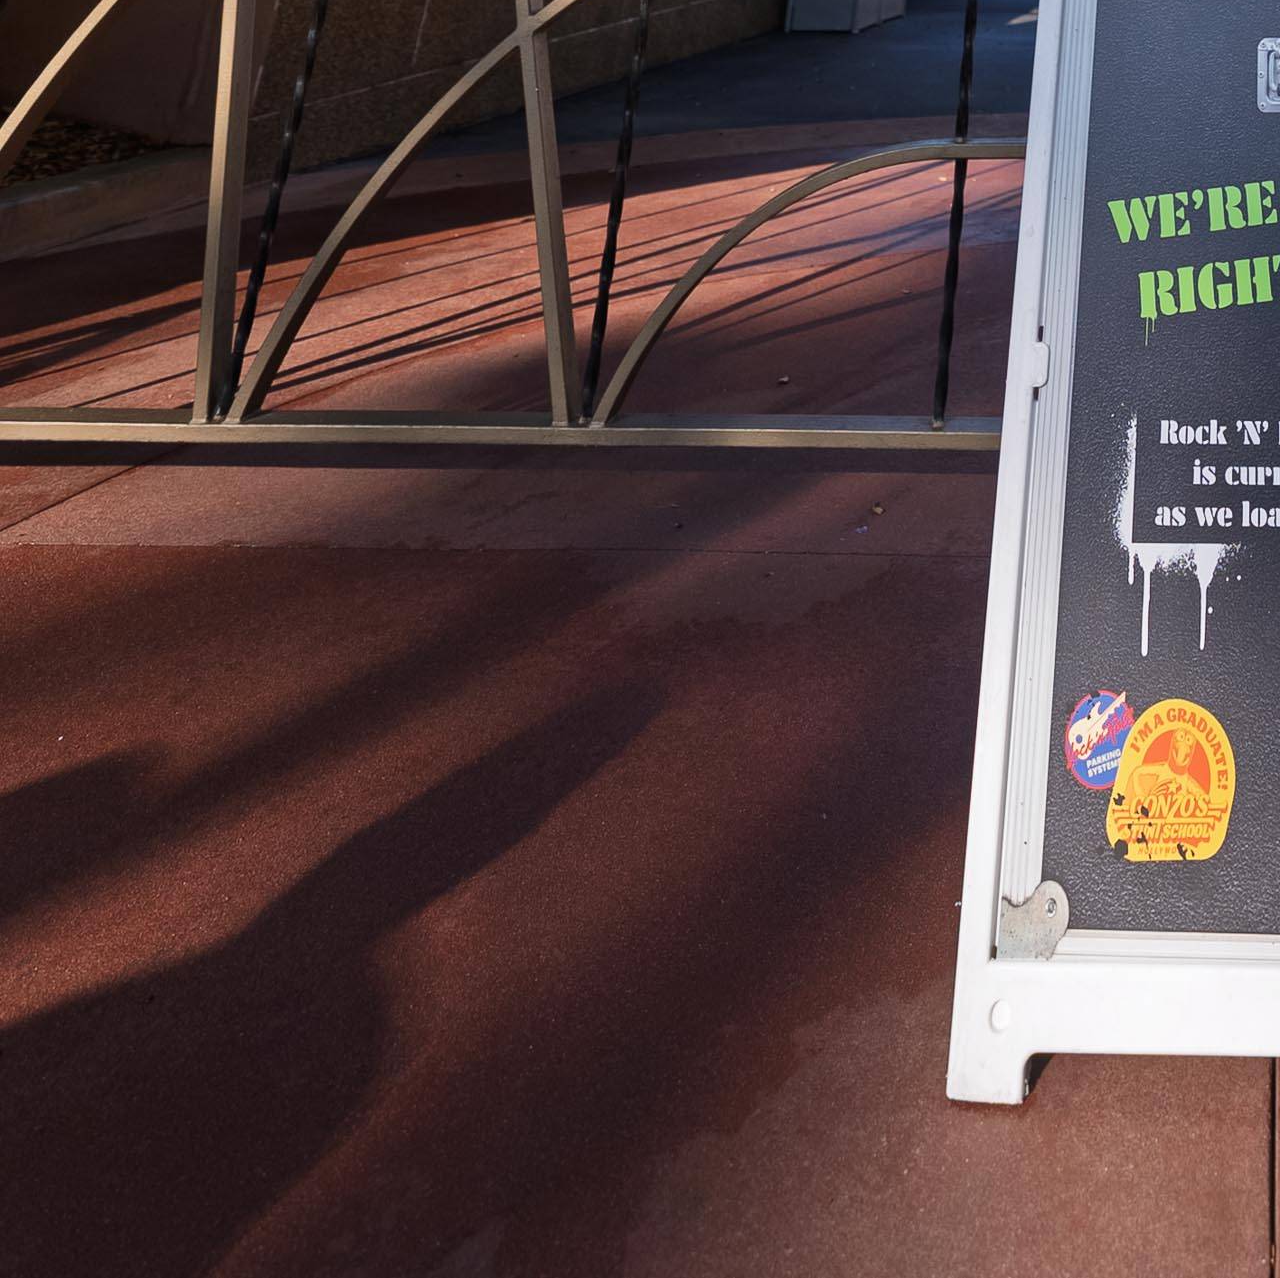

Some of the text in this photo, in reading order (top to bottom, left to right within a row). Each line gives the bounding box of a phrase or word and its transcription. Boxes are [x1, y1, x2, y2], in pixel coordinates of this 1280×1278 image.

[1107, 180, 1278, 243] WE'RE
[1160, 420, 1227, 445] Rock
[1237, 421, 1268, 444] 'N'
[1192, 459, 1216, 485] is
[1154, 505, 1186, 528] as
[1195, 507, 1232, 528] we
[1130, 722, 1153, 753] I'M
[1153, 713, 1164, 729] A
[1162, 822, 1210, 841] SCHOOL
